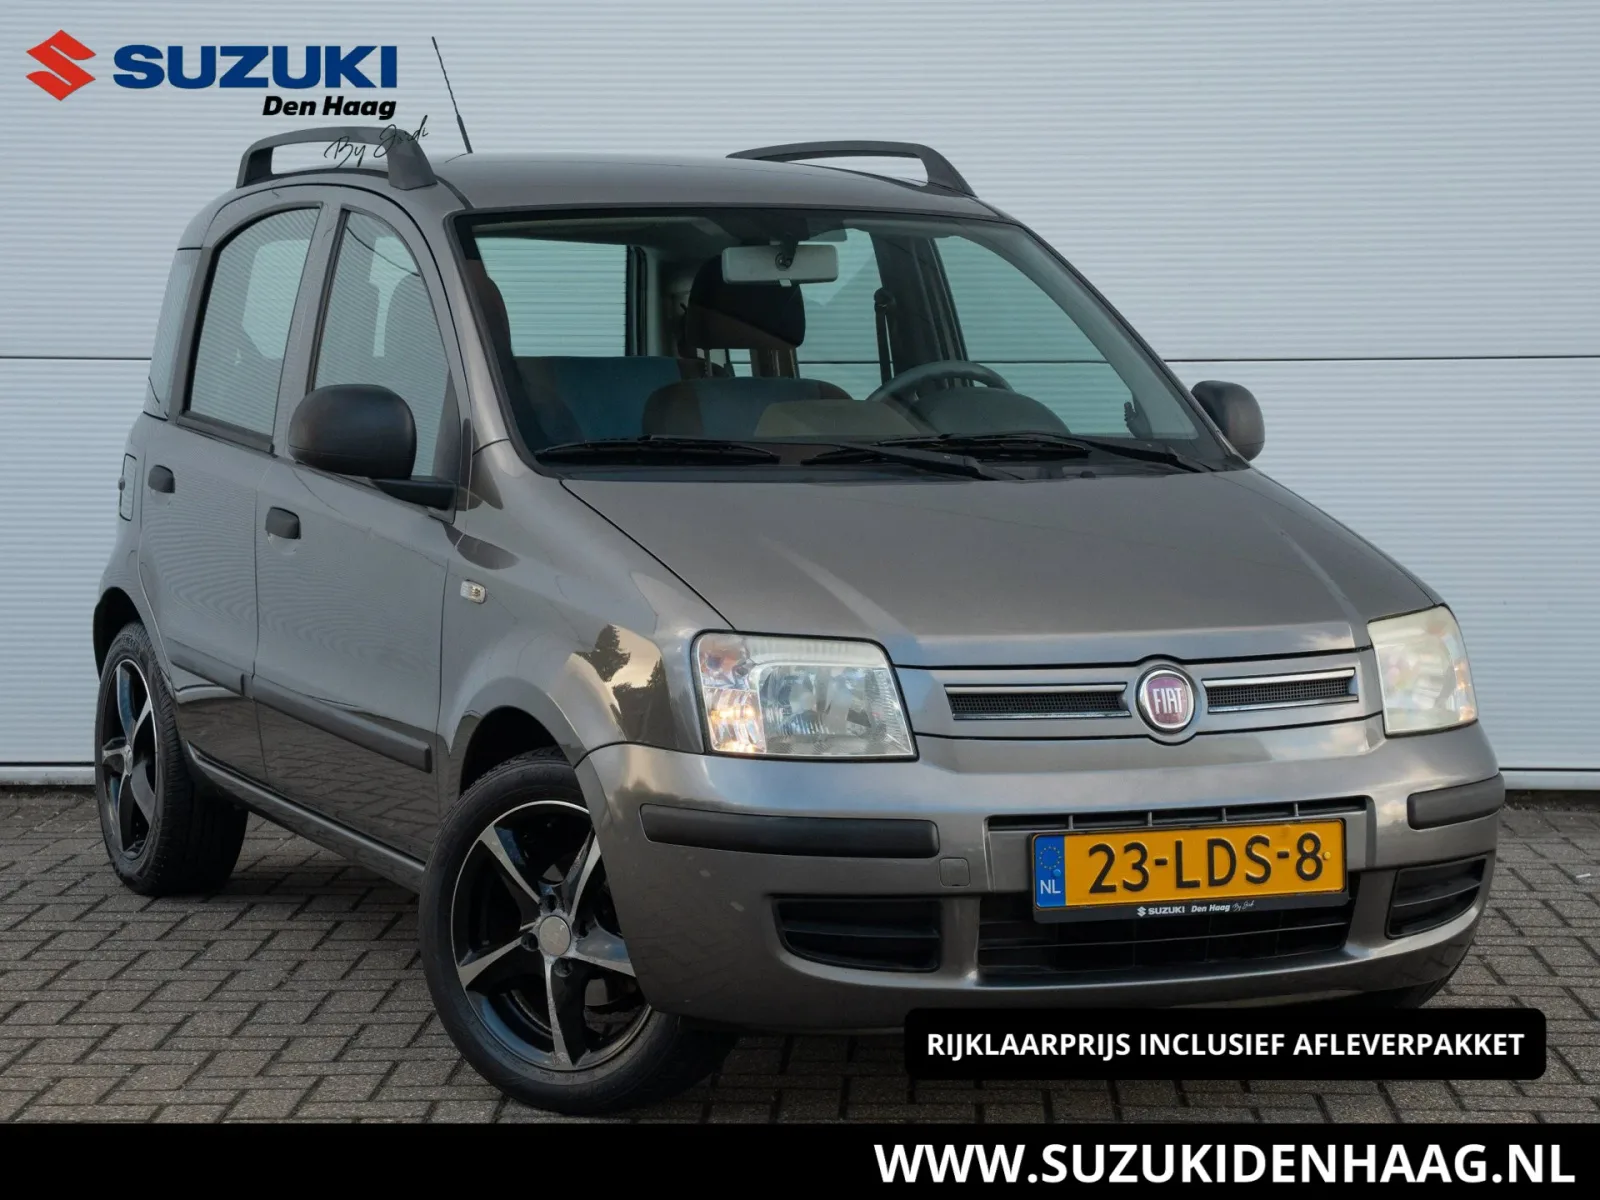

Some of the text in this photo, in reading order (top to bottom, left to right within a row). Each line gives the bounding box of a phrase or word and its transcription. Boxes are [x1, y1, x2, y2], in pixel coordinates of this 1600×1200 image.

[1152, 687, 1183, 715] FIAT
[1088, 831, 1324, 894] 23-LDS-8
[1039, 879, 1062, 895] NL
[1148, 905, 1186, 915] SUZUKI
[1191, 905, 1208, 913] Den
[1209, 903, 1231, 912] Haag
